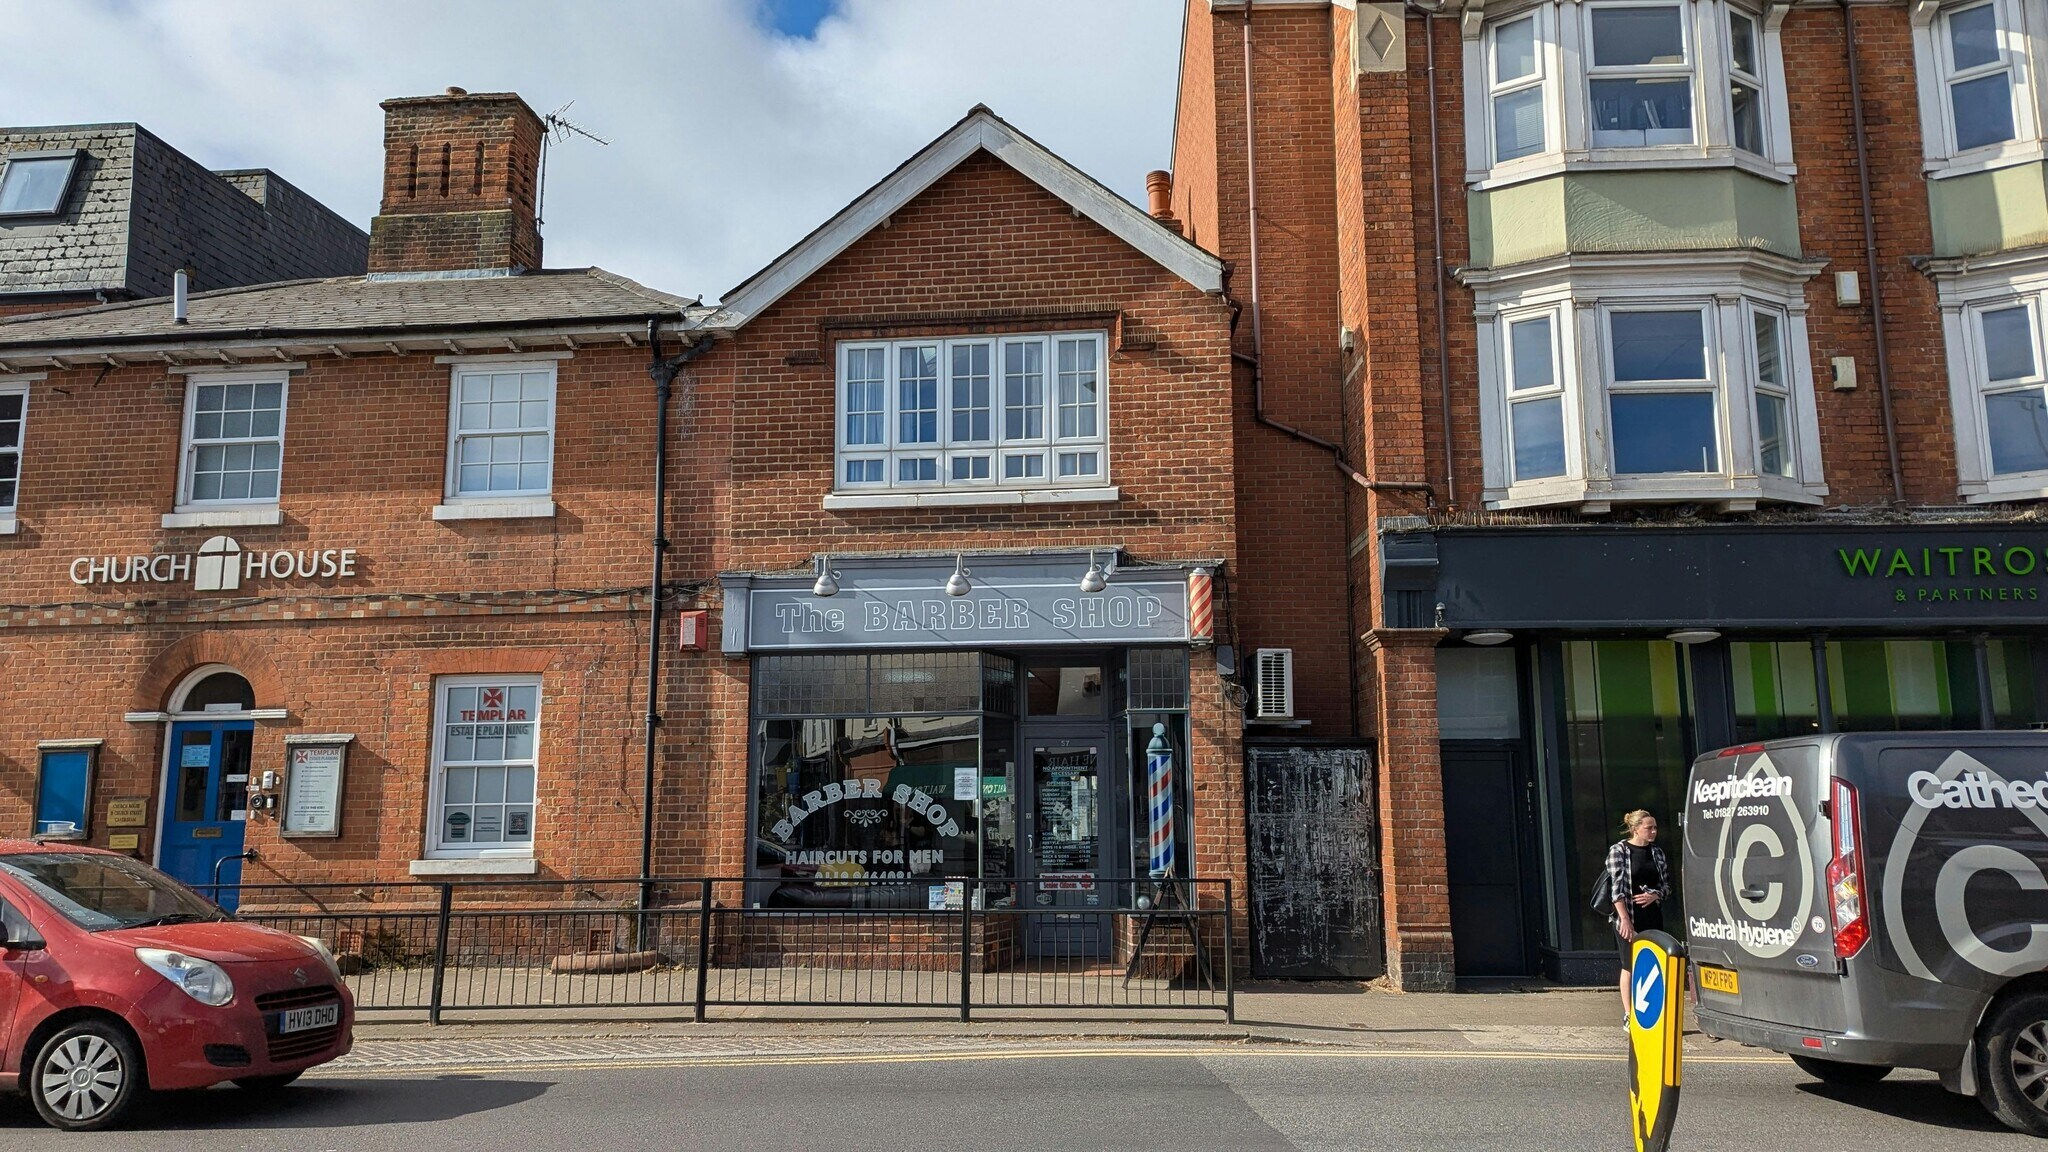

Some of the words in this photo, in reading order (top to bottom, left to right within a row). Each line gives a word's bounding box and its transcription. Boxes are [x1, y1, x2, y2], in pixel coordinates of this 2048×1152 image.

[69, 554, 190, 585] CHURCH
[245, 549, 357, 579] HOUSE
[1838, 546, 2048, 577] WAITRO
[1895, 589, 1907, 601] &
[1918, 588, 2038, 601] PARTNERS
[775, 602, 845, 633] The
[863, 599, 1030, 632] BARBER
[1052, 596, 1162, 629] SHOP
[460, 709, 527, 721] TEMPLAR
[450, 725, 482, 736] ESTATE
[483, 725, 529, 736] PLANNING
[1693, 771, 1793, 806] Keepitclean
[771, 778, 883, 843] BARBER
[892, 783, 960, 838] SHOP
[1702, 809, 1714, 820] Tel:
[1714, 806, 1735, 818] 01827
[1737, 804, 1769, 817] 263910
[785, 850, 867, 865] HAIRCUTS
[872, 850, 904, 864] FOR
[909, 849, 944, 864] MEN
[1690, 916, 1737, 940] Cathedral
[1738, 919, 1795, 948] Hygiene
[288, 1010, 312, 1029] HV13
